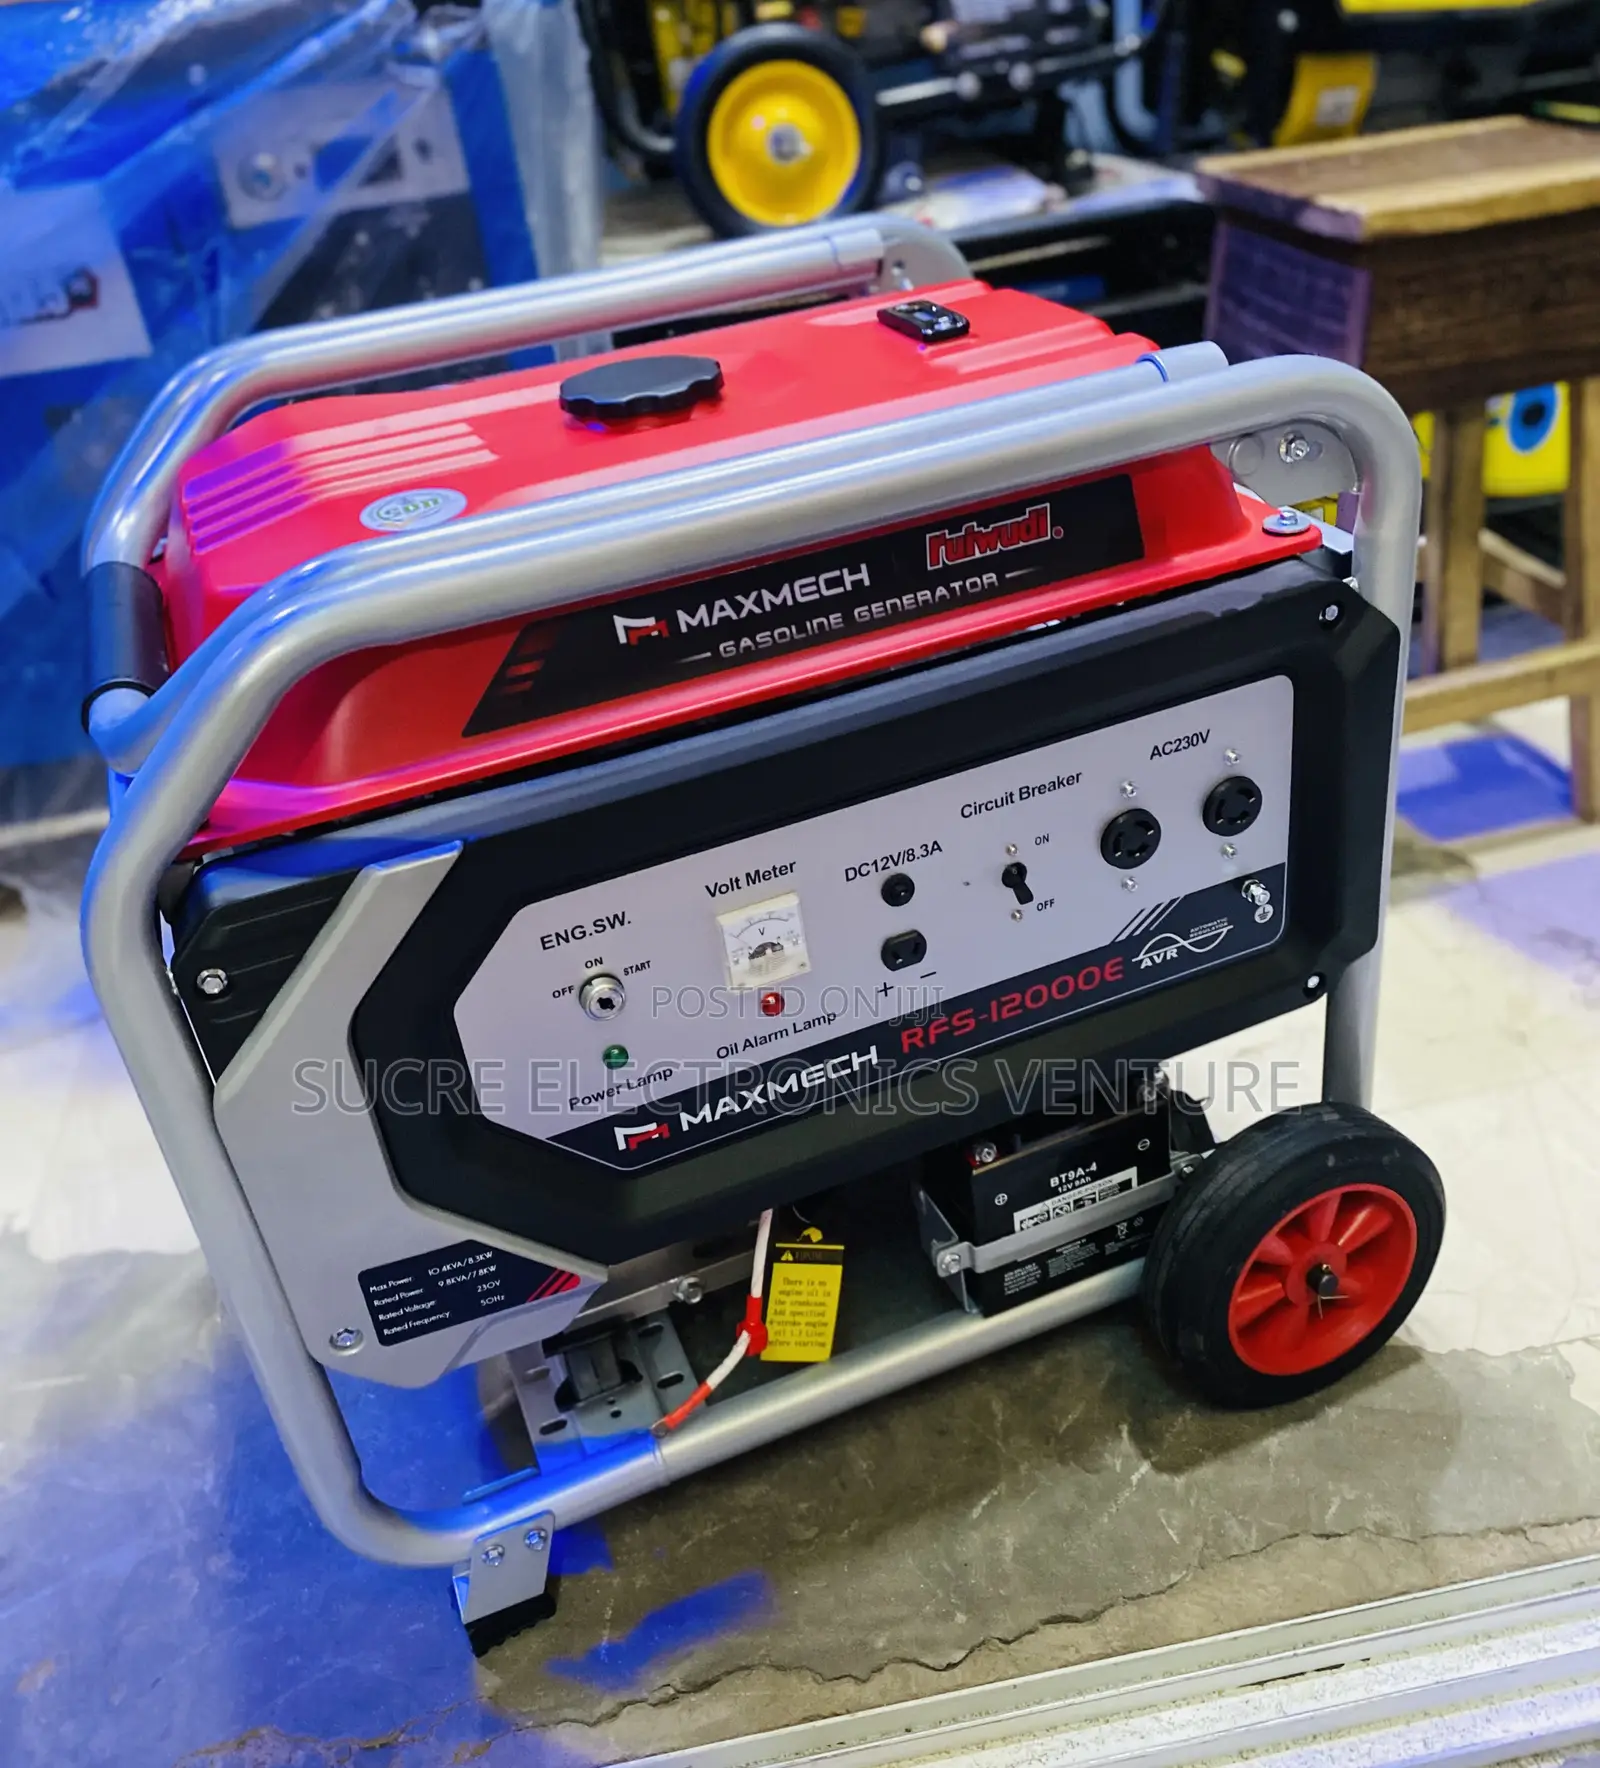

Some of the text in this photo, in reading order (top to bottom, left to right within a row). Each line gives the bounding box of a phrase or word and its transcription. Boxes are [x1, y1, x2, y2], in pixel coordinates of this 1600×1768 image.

[676, 563, 871, 634] MAXMECH
[719, 572, 999, 658] GASOLINE GENERATOR
[1149, 729, 1211, 760] AC230V
[960, 771, 1082, 819] Circuit Breaker
[1034, 833, 1050, 846] ON
[705, 861, 797, 898] Volt Meter
[844, 839, 943, 883] DC12V/8.3A
[1036, 898, 1055, 912] OFF
[540, 911, 632, 951] ENG.SW.
[584, 956, 604, 969] ON
[623, 960, 652, 976] START
[1140, 948, 1179, 969] AVR
[552, 985, 575, 999] OFF
[902, 956, 1125, 1053] RFS-12000E
[716, 1011, 837, 1060] Oil Alarm Lamp
[569, 1067, 674, 1111] Power Lamp
[680, 1044, 879, 1132] MAXMECH
[1050, 1161, 1098, 1188] BT9A-4
[373, 1293, 399, 1307] Rated
[378, 1308, 404, 1321] Rated
[476, 1279, 502, 1294] 230V
[383, 1323, 408, 1336] Rated
[480, 1294, 505, 1307] 50Hz
